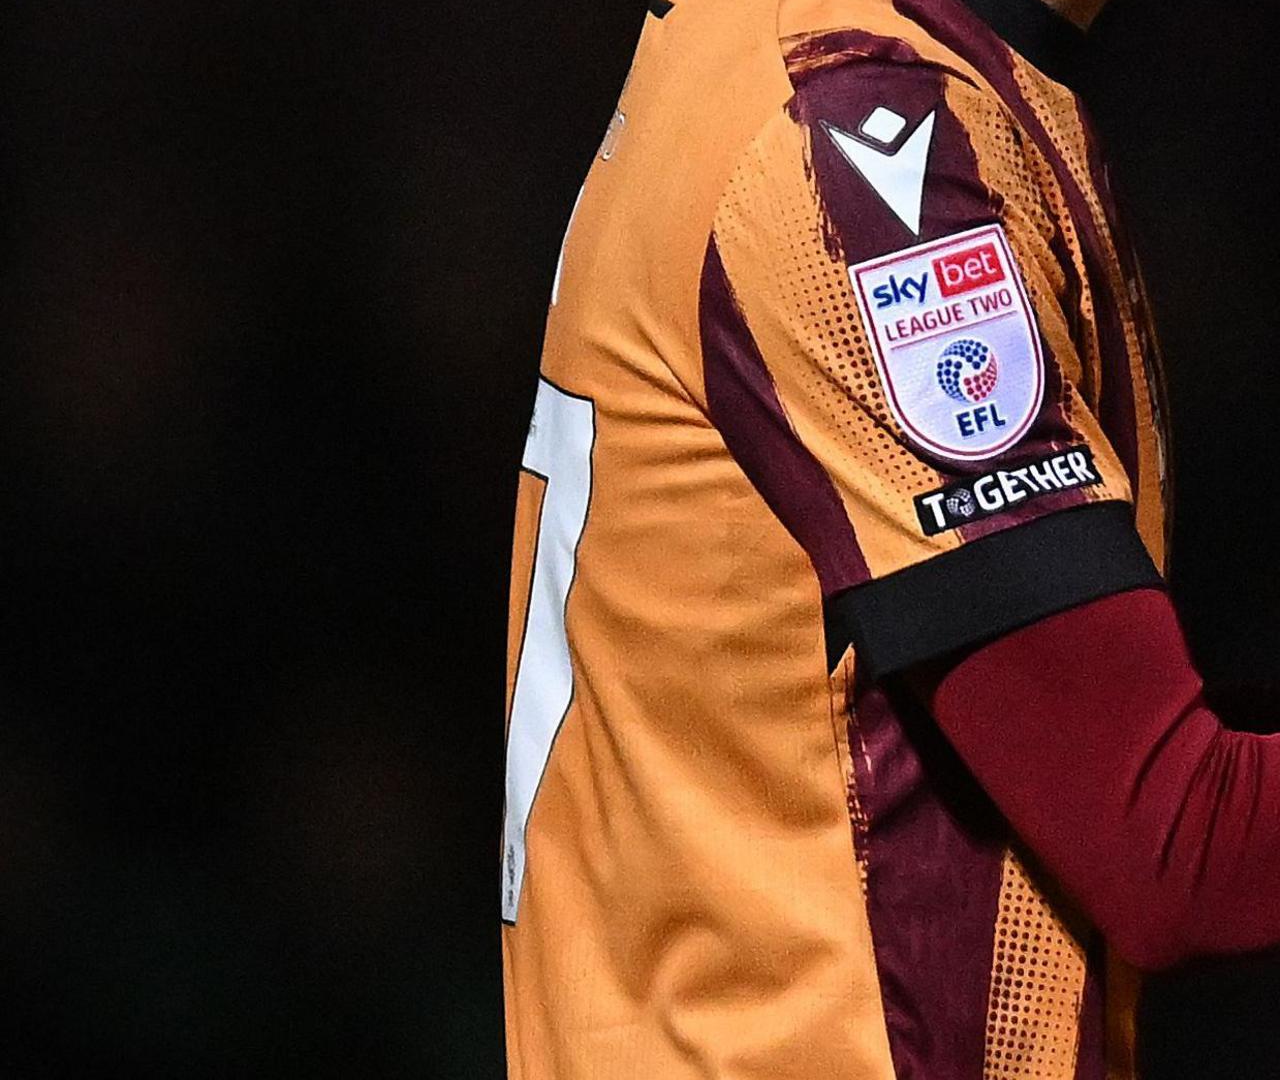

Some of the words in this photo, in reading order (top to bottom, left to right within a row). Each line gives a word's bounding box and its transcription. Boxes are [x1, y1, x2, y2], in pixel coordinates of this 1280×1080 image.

[872, 271, 929, 308] sky
[941, 251, 996, 287] bet
[884, 302, 965, 341] LEAGUE
[967, 288, 1013, 315] TWO
[956, 409, 1006, 438] EFL
